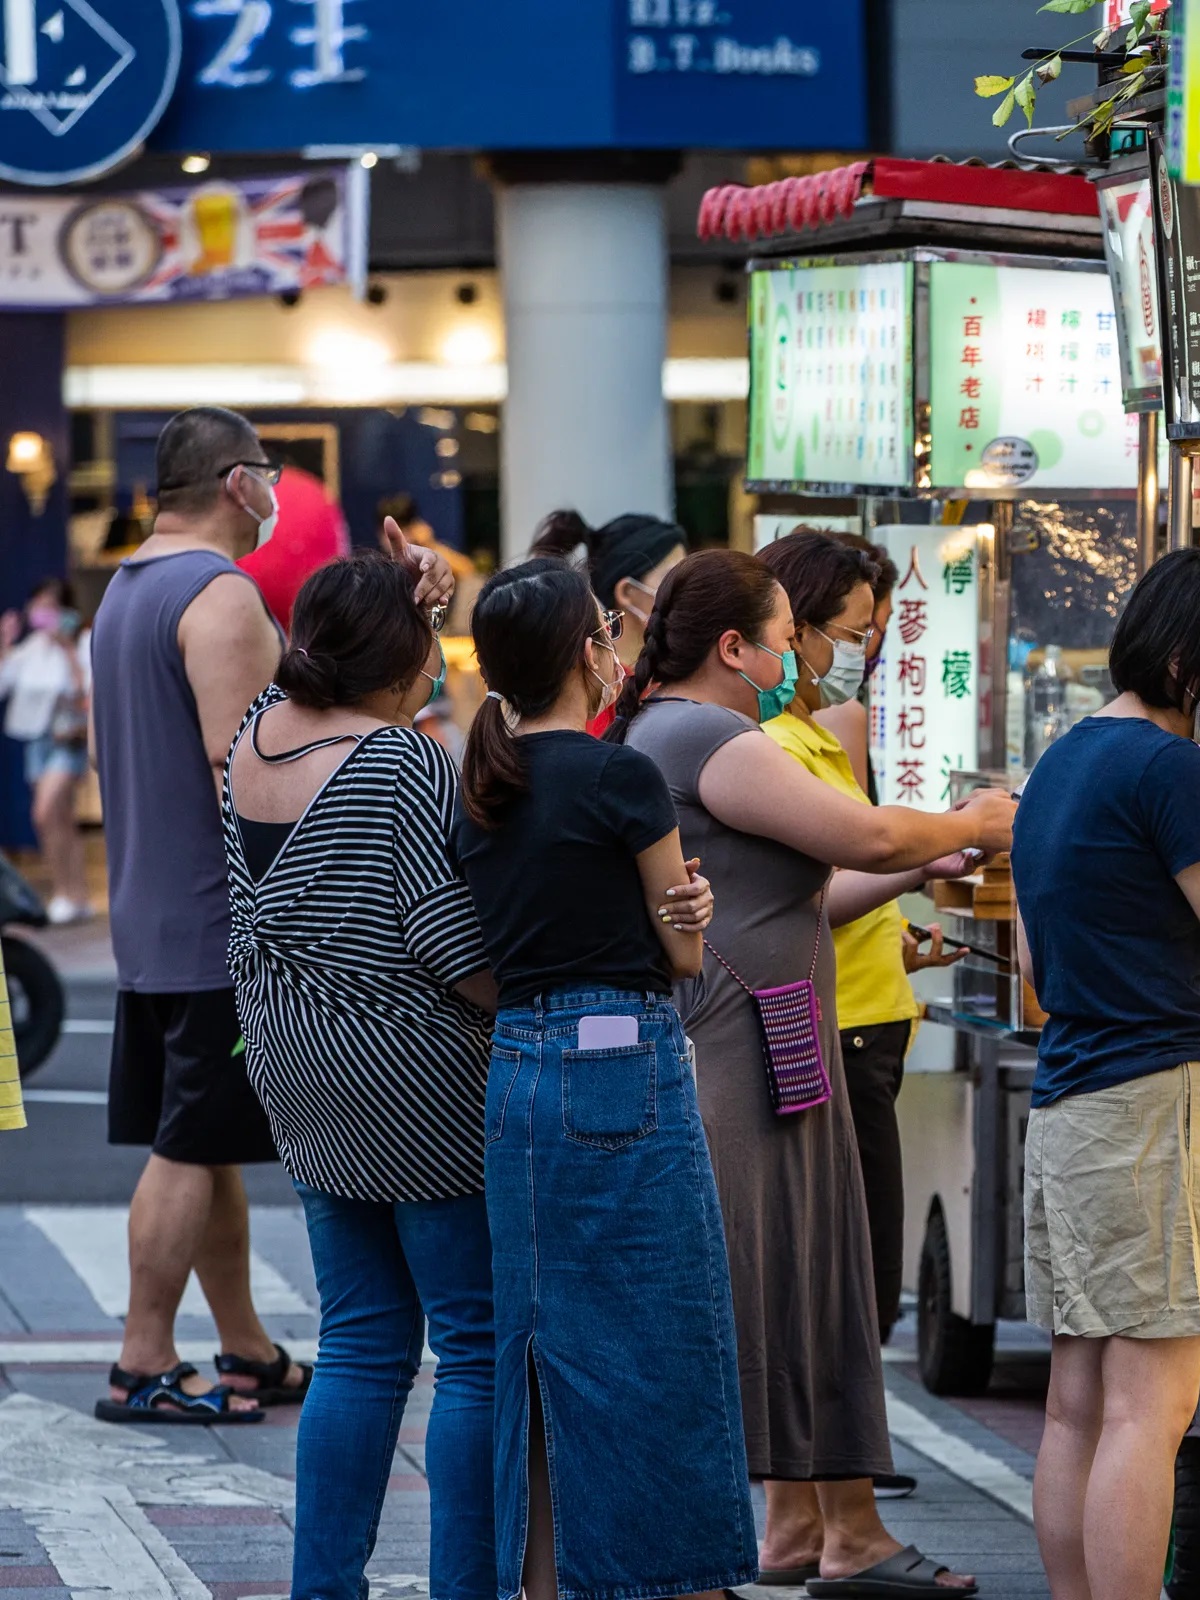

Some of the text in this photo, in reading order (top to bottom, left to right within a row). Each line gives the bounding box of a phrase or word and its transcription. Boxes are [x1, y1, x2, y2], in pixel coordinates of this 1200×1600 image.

[959, 316, 982, 430] 百年老店
[1025, 309, 1047, 394] 楊桃汁
[896, 545, 928, 802] 人蔘枸杞茶
